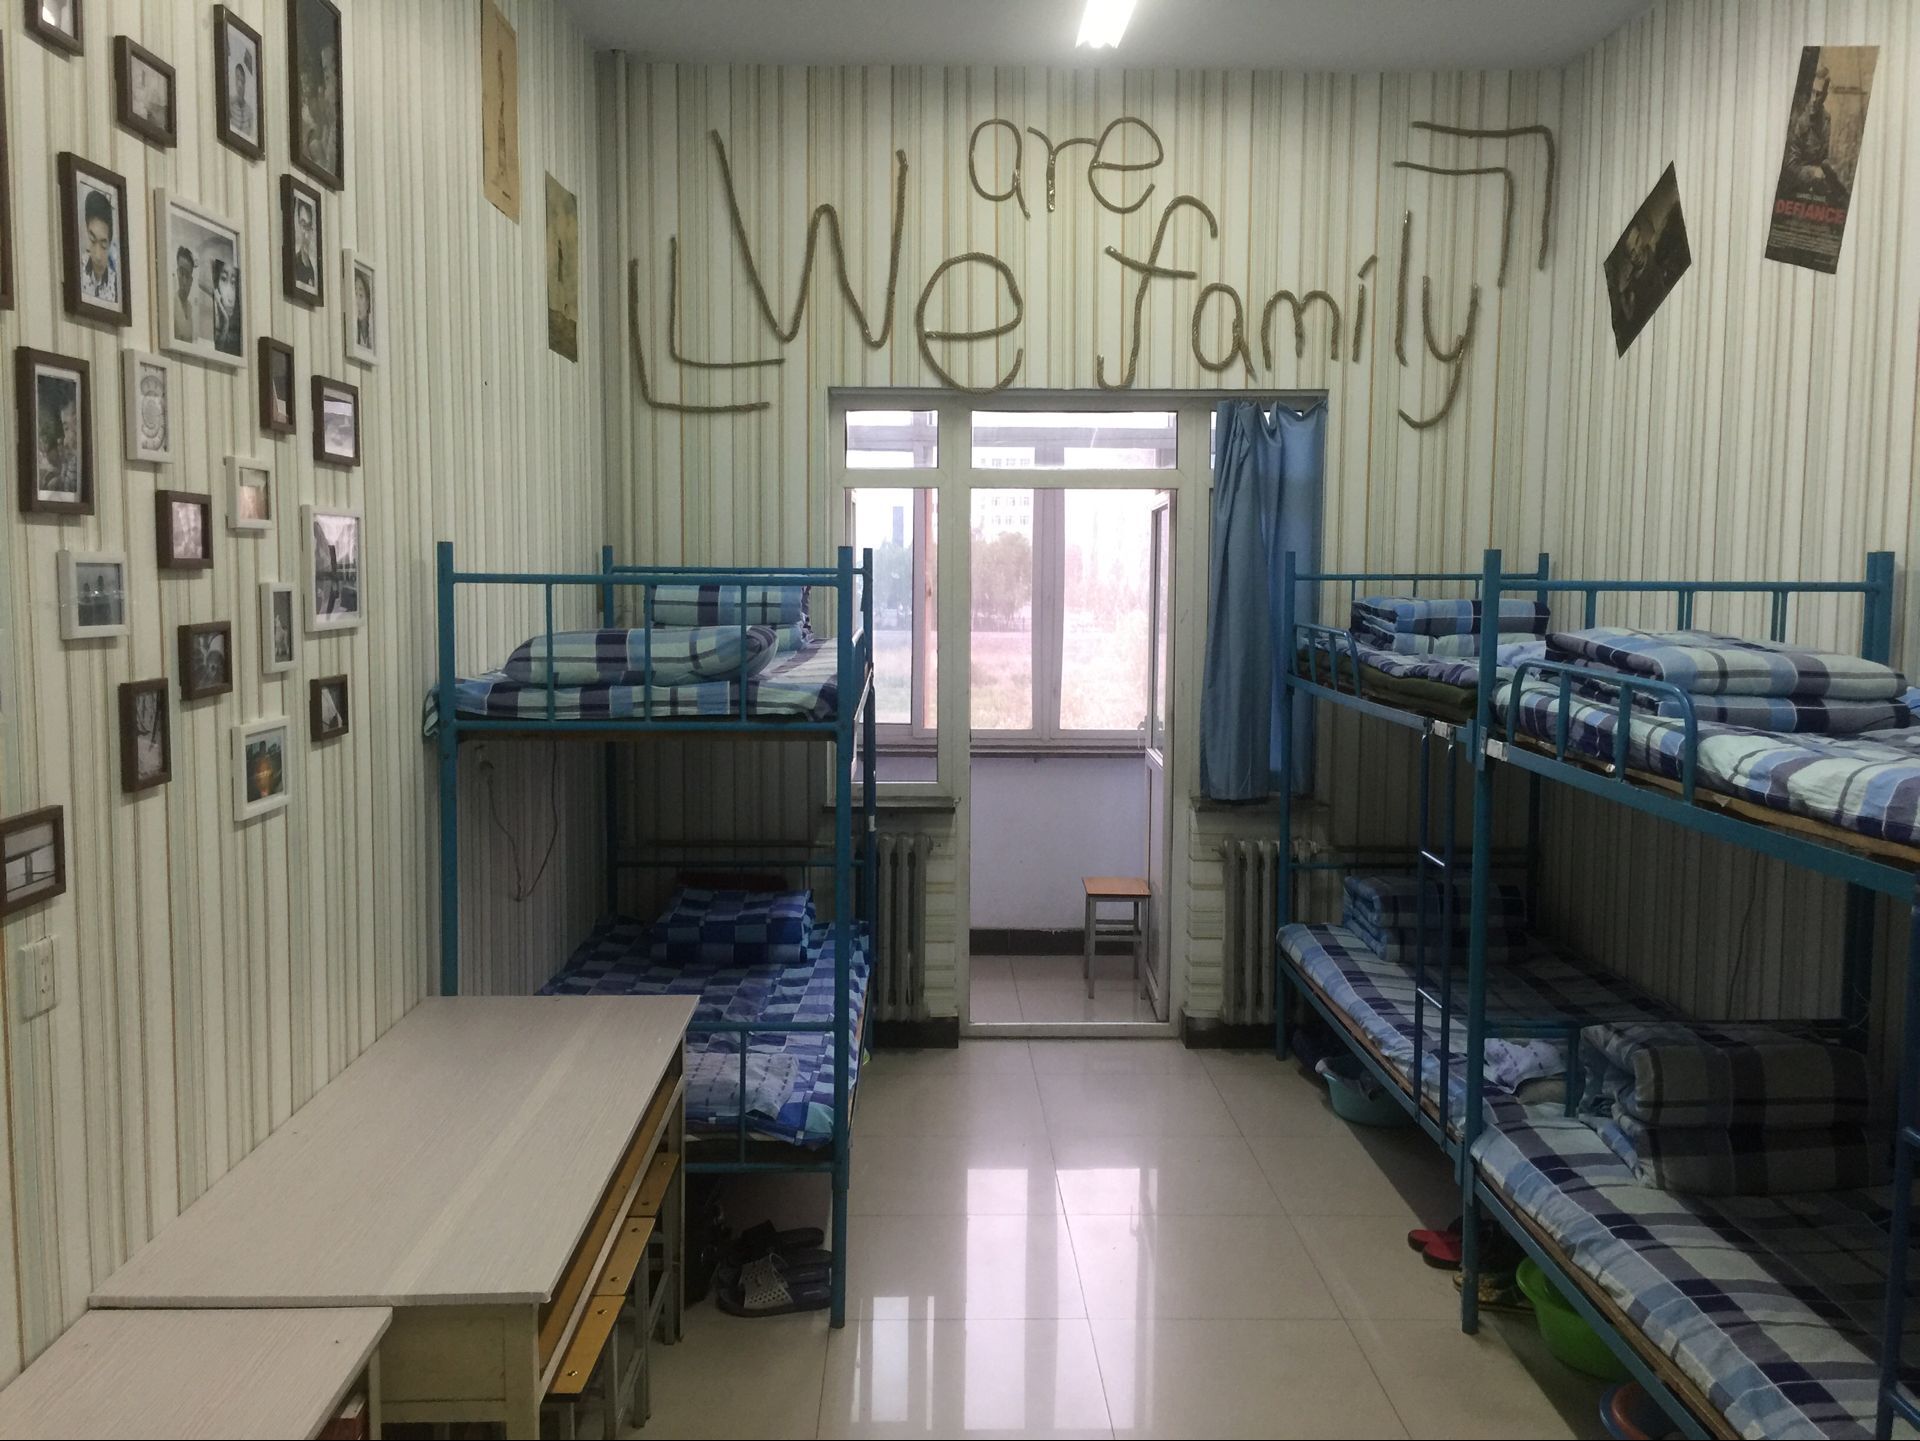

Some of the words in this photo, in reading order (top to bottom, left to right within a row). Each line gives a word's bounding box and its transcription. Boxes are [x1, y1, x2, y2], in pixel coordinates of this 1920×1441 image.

[712, 129, 1023, 392] We
[968, 117, 1163, 219] are
[1097, 196, 1479, 428] family
[1775, 199, 1846, 223] DEFIANCE
